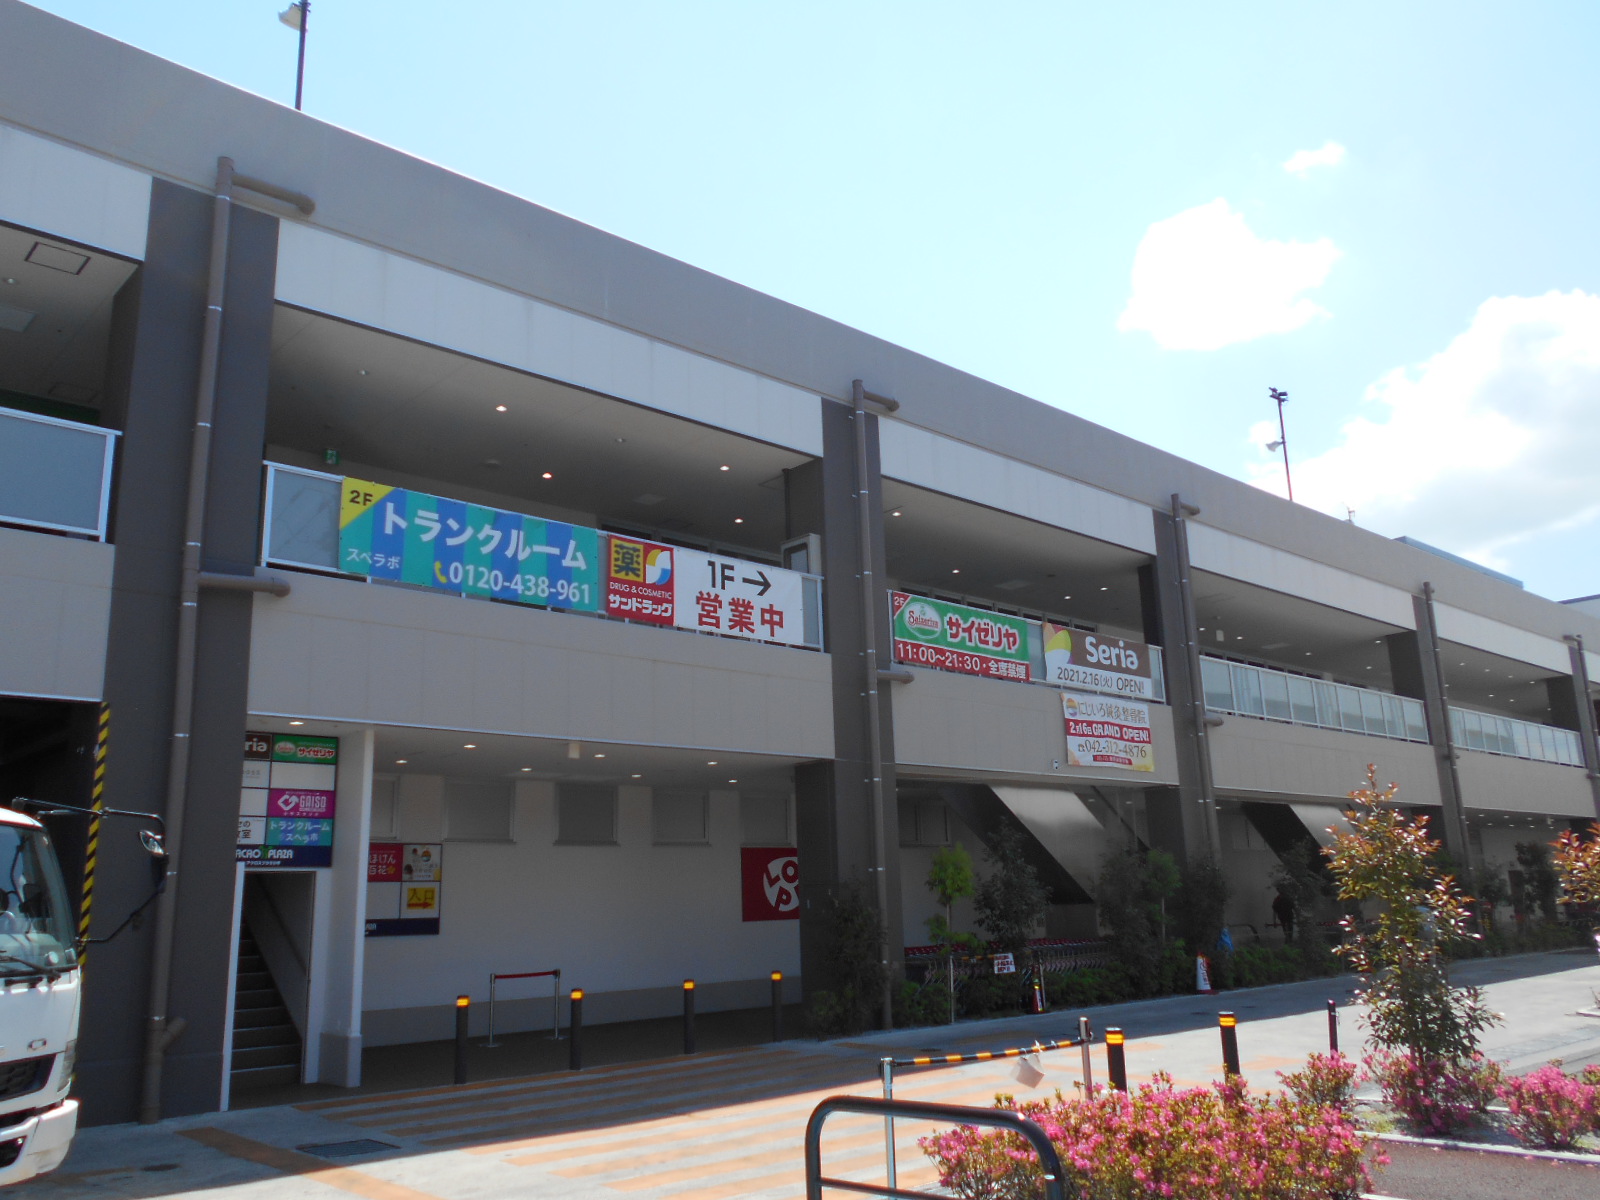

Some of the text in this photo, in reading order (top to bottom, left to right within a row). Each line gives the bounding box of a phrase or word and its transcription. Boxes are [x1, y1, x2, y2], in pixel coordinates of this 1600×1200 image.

[349, 490, 374, 506] 2F
[384, 502, 587, 570] トランクルーム
[346, 547, 401, 570] スペラボ
[613, 543, 642, 579] 薬
[449, 561, 590, 604] 0120-438-961
[707, 560, 735, 591] 1F
[609, 581, 630, 592] DRUG
[637, 586, 672, 600] COSMETIC
[608, 593, 673, 617] サンドラッグ
[894, 596, 906, 607] 2F
[695, 590, 784, 638] 営業中
[945, 614, 1018, 652] サイゼリヤ
[1085, 636, 1139, 670] Seria
[1116, 677, 1145, 695] OPEN!
[1092, 723, 1121, 738] GRAND
[1122, 727, 1149, 742] OPEN!
[1084, 739, 1147, 758] 042-312-4876
[300, 795, 327, 808] GAISO
[269, 820, 330, 831] トランクルーム
[267, 849, 294, 859] PLAZA
[407, 887, 435, 903] 入口
